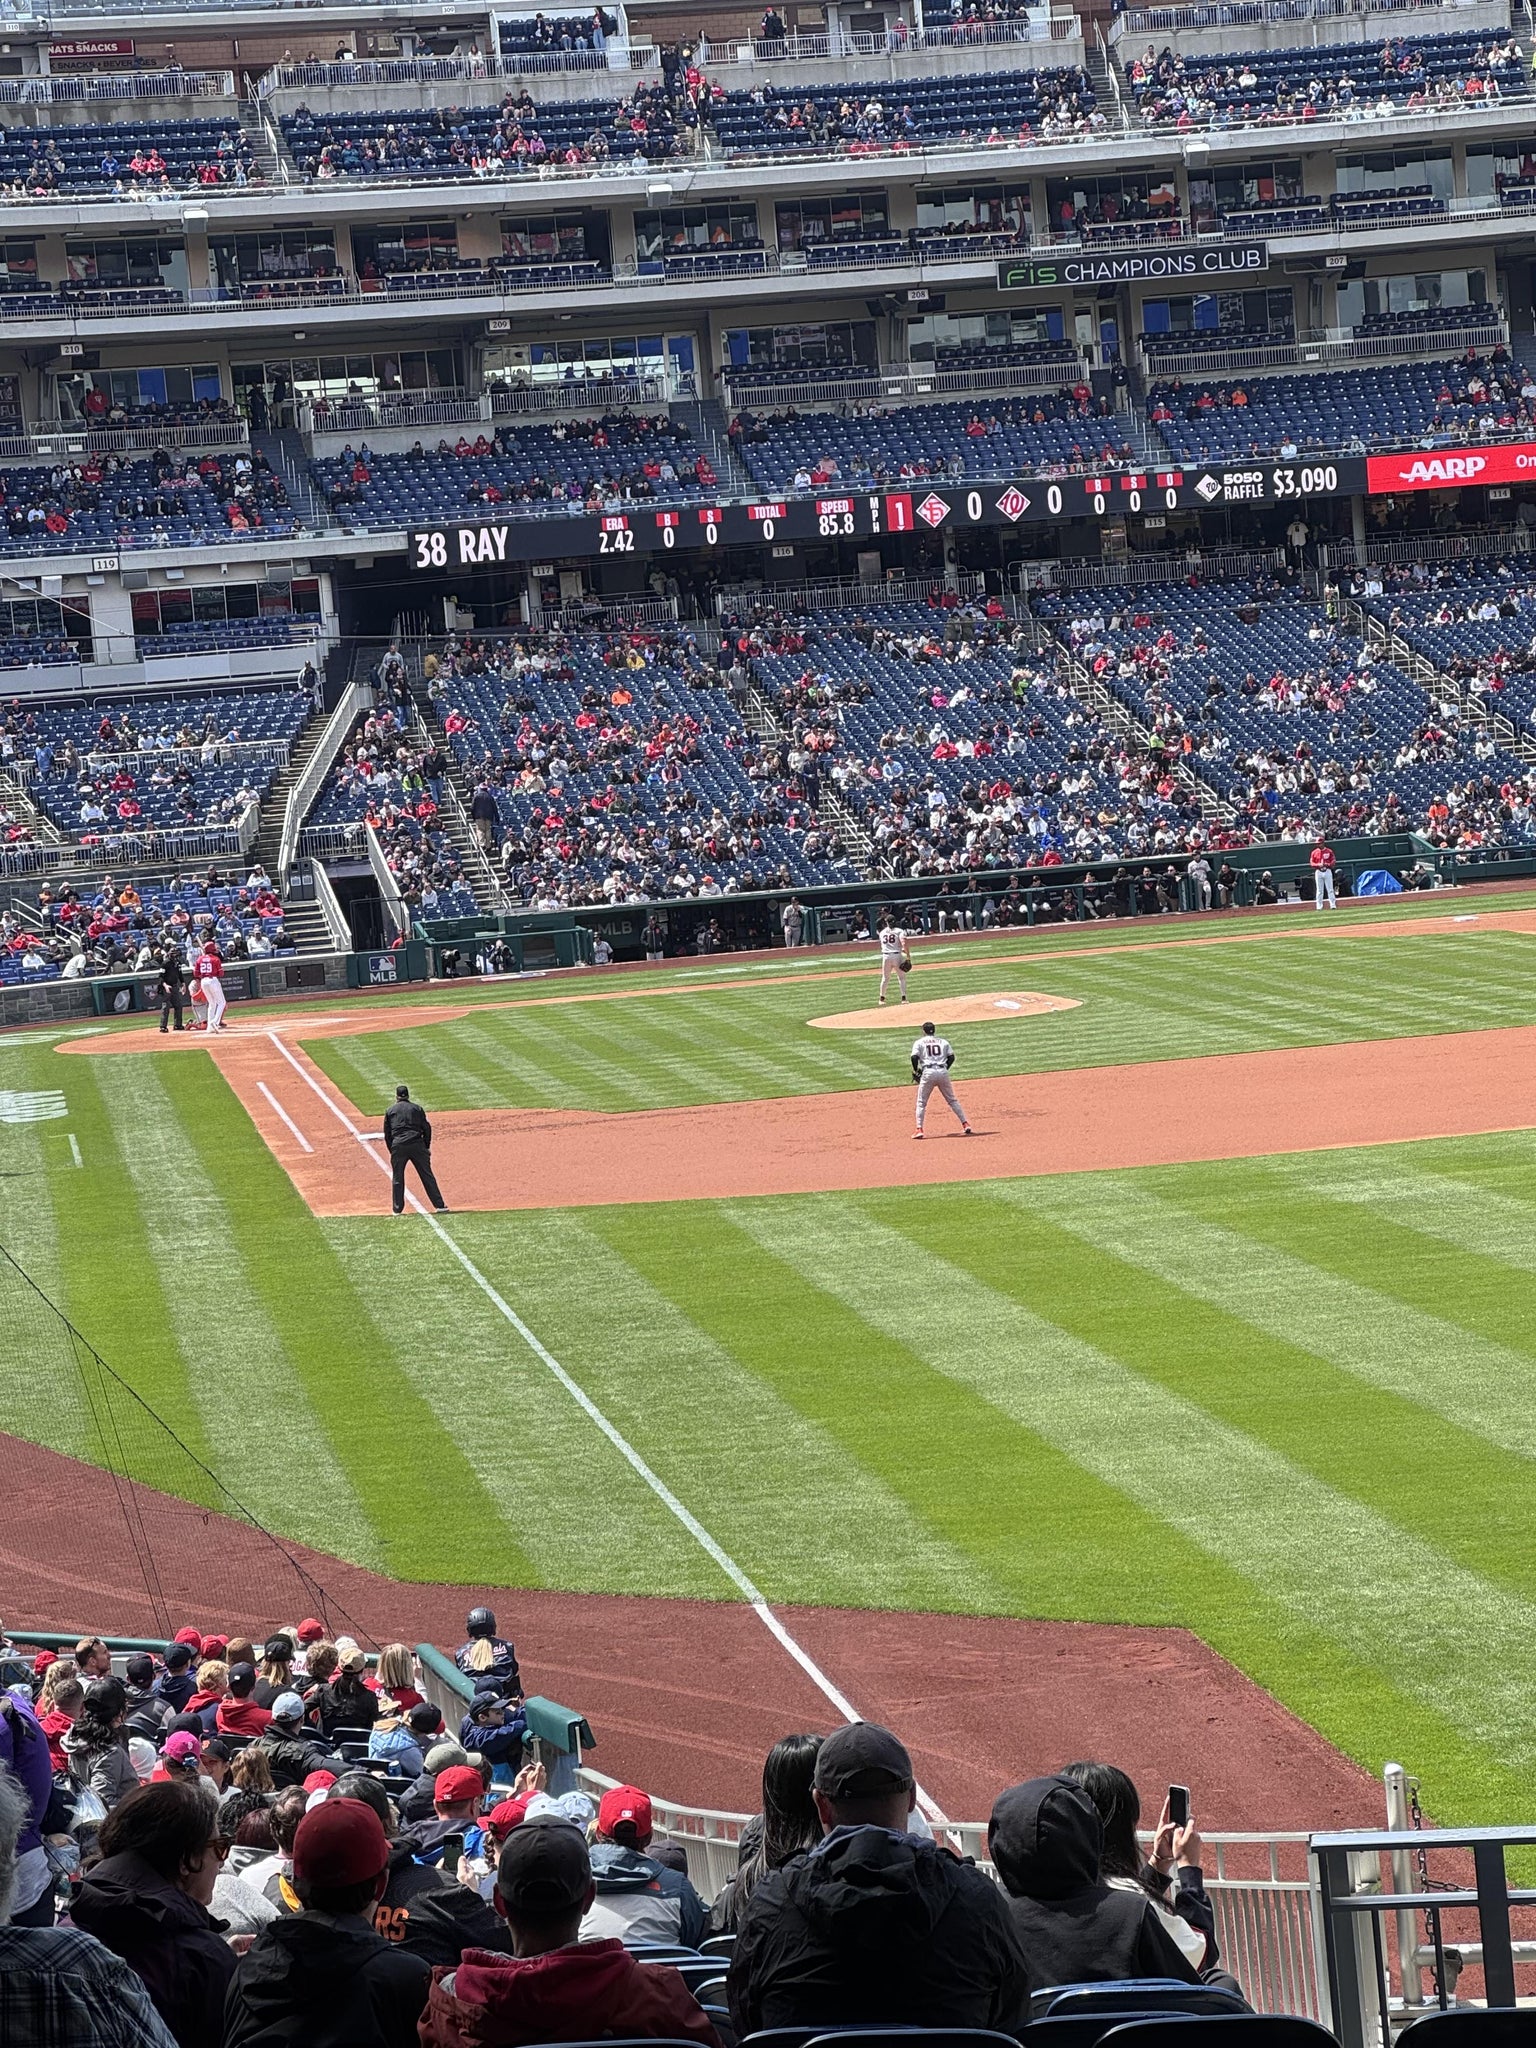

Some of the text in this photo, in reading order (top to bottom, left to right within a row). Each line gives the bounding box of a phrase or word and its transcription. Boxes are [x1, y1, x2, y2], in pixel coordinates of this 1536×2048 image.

[48, 43, 118, 54] NATS SNACKS
[58, 62, 94, 70] SNACKS
[104, 58, 157, 68] BEVERGES
[1064, 254, 1196, 282] CHAMPIONS
[1202, 250, 1262, 271] CLUB
[1330, 257, 1344, 265] 207
[912, 290, 926, 298] 208
[492, 320, 508, 328] 209
[64, 346, 80, 354] 210
[1399, 456, 1486, 482] AARP
[1130, 476, 1137, 489] S
[1223, 472, 1264, 484] 5050
[1273, 466, 1337, 498] $3,090
[1094, 479, 1102, 492] B
[1224, 483, 1264, 500] RAFFLE
[967, 491, 982, 520] 0
[1047, 485, 1062, 514] 0
[1094, 493, 1105, 515] 0
[1130, 491, 1141, 512] 0
[1166, 488, 1177, 509] 0
[754, 505, 781, 519] TOTAL
[820, 500, 849, 514] SPEED
[895, 502, 904, 526] 1
[664, 514, 672, 526] B
[706, 510, 714, 523] S
[606, 517, 624, 531] ERA
[763, 519, 774, 540] 0
[818, 513, 854, 536] 85.8
[663, 526, 675, 548] 0
[706, 524, 718, 545] 0
[414, 526, 509, 568] 38 RAY
[598, 530, 635, 554] 2.42
[97, 560, 115, 570] 119
[536, 566, 551, 574] 117
[600, 920, 632, 936] MLB
[882, 934, 896, 944] 38
[200, 963, 212, 973] 29
[370, 971, 397, 983] MLB
[926, 1044, 942, 1056] 10
